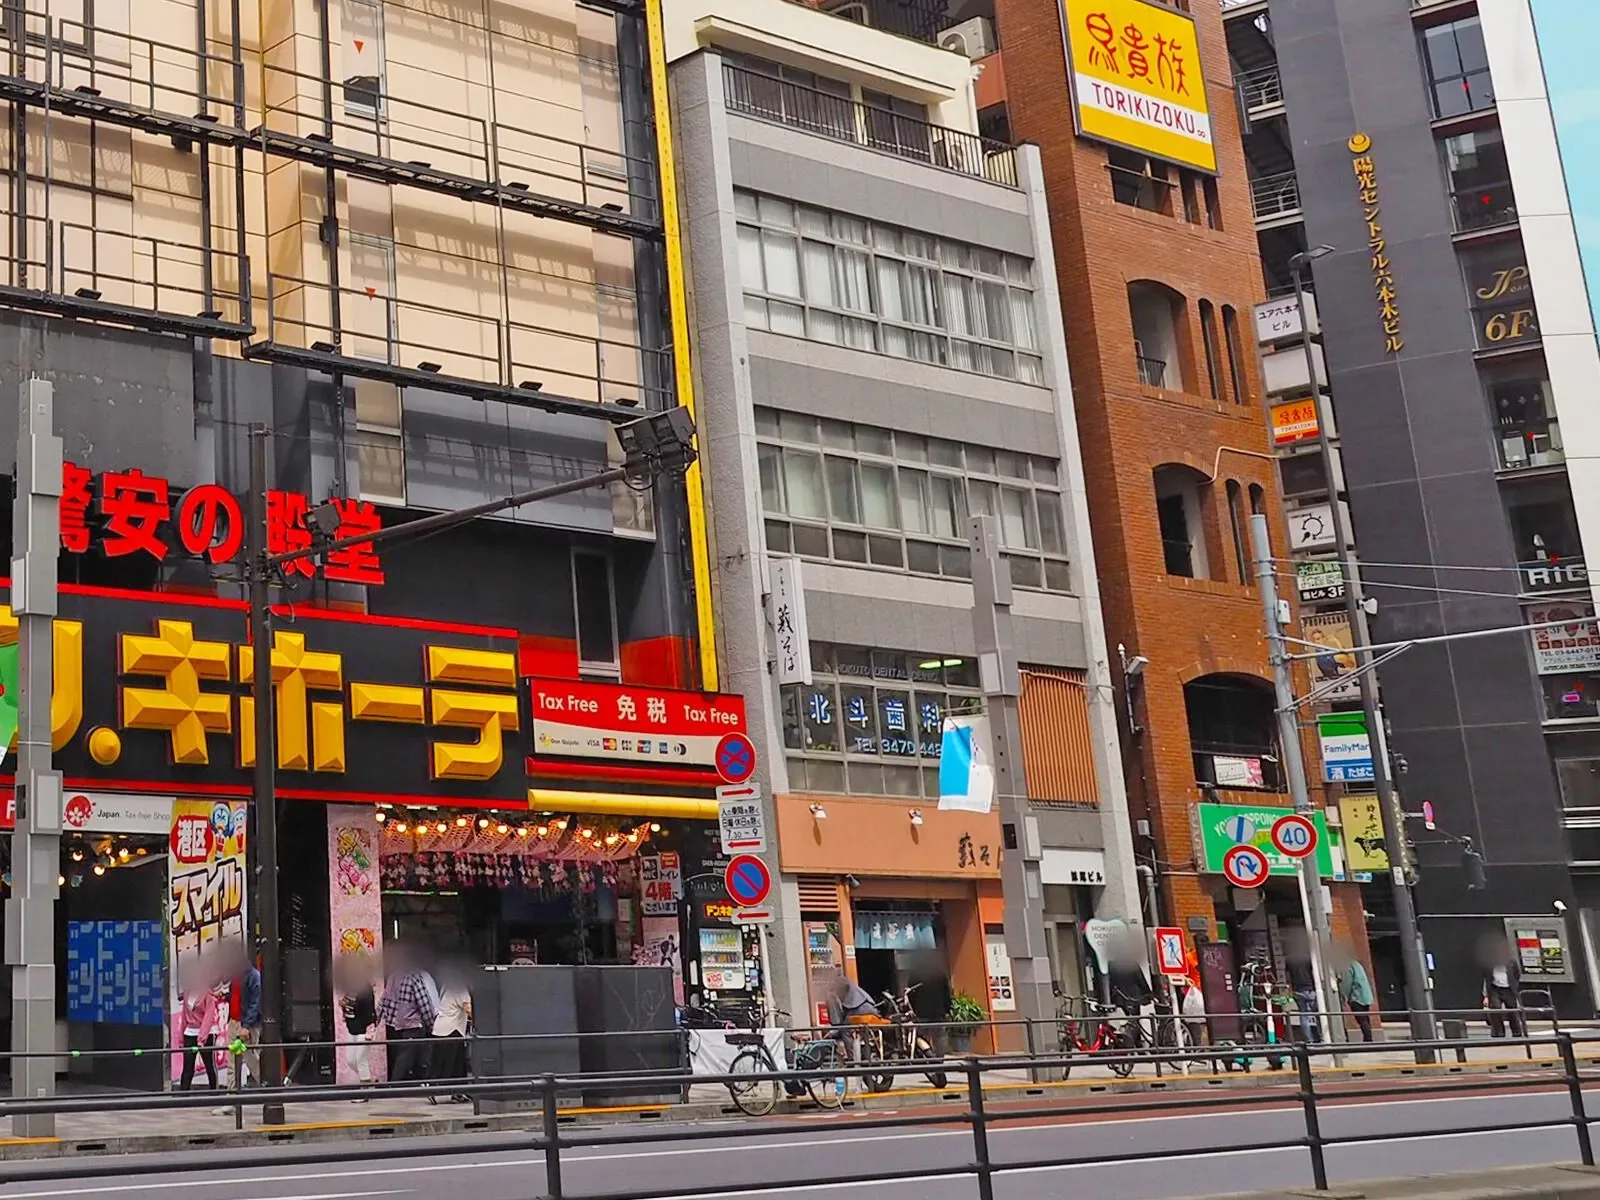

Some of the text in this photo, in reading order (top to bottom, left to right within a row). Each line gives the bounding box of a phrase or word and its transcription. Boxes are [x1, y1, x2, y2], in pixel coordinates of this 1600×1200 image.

[1092, 82, 1196, 134] TORIKIZOKU
[1353, 156, 1404, 353] 陽光セントラル六本木ビル
[1272, 321, 1292, 332] ビル
[1328, 586, 1345, 597] 3F
[538, 693, 598, 712] Tax Free
[617, 694, 667, 723] 免税
[684, 705, 738, 725] Tax Free
[809, 694, 941, 733] 北斗歯科
[855, 737, 875, 752] TEL
[883, 741, 916, 753] 3470
[1324, 743, 1369, 753] FamilyMar
[1331, 767, 1374, 779] 酒 たばこ
[154, 813, 171, 822] Shop
[177, 819, 207, 858] 港区
[1282, 827, 1307, 845] 40
[660, 871, 678, 880] トイレ
[171, 860, 242, 932] スマイル
[645, 903, 677, 912] ございます
